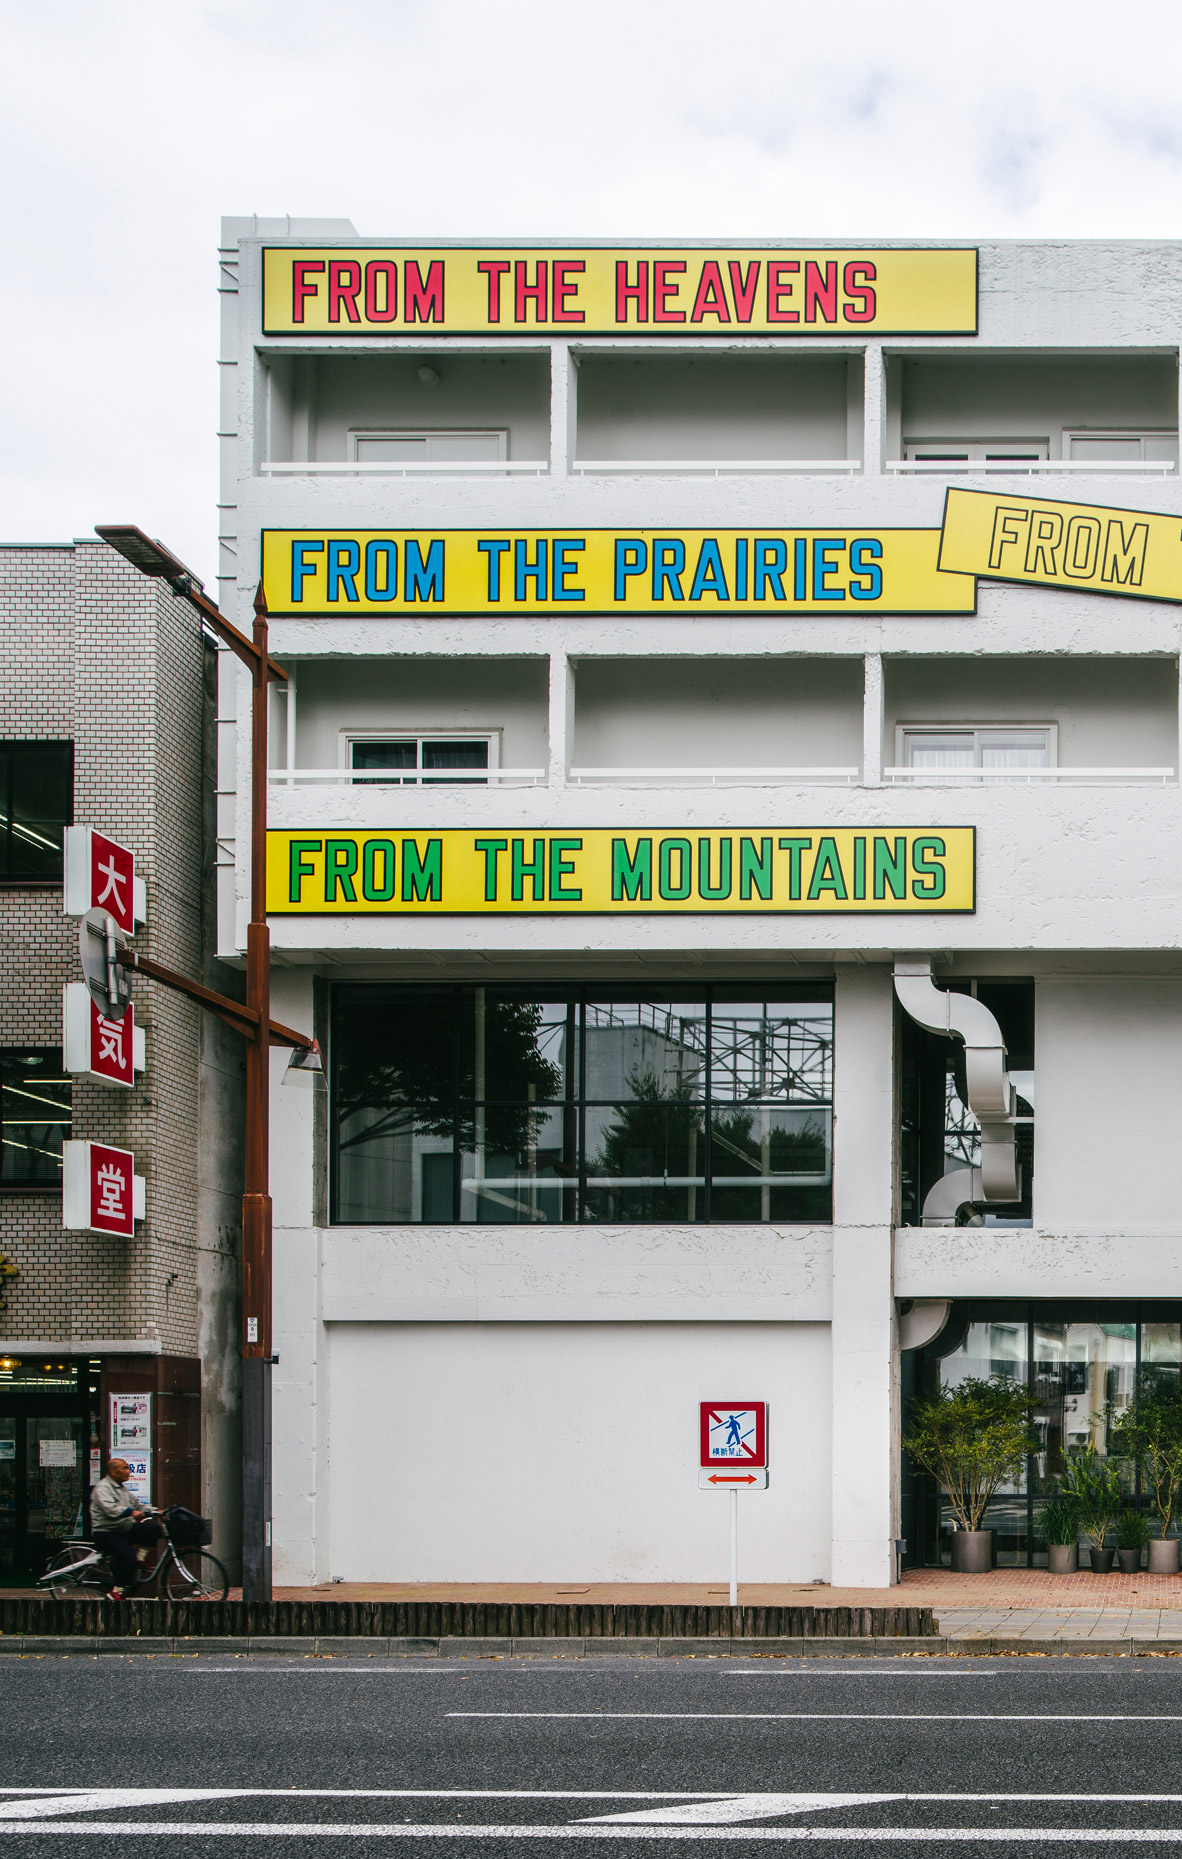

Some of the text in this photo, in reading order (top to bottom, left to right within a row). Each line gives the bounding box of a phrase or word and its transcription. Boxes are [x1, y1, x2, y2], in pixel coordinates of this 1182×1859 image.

[292, 260, 877, 323] FROM THE HEAVENS
[290, 538, 884, 603] FROM THE PRAIRIES
[988, 505, 1150, 587] FROM
[288, 836, 946, 903] FROM THE MOUNTAINS
